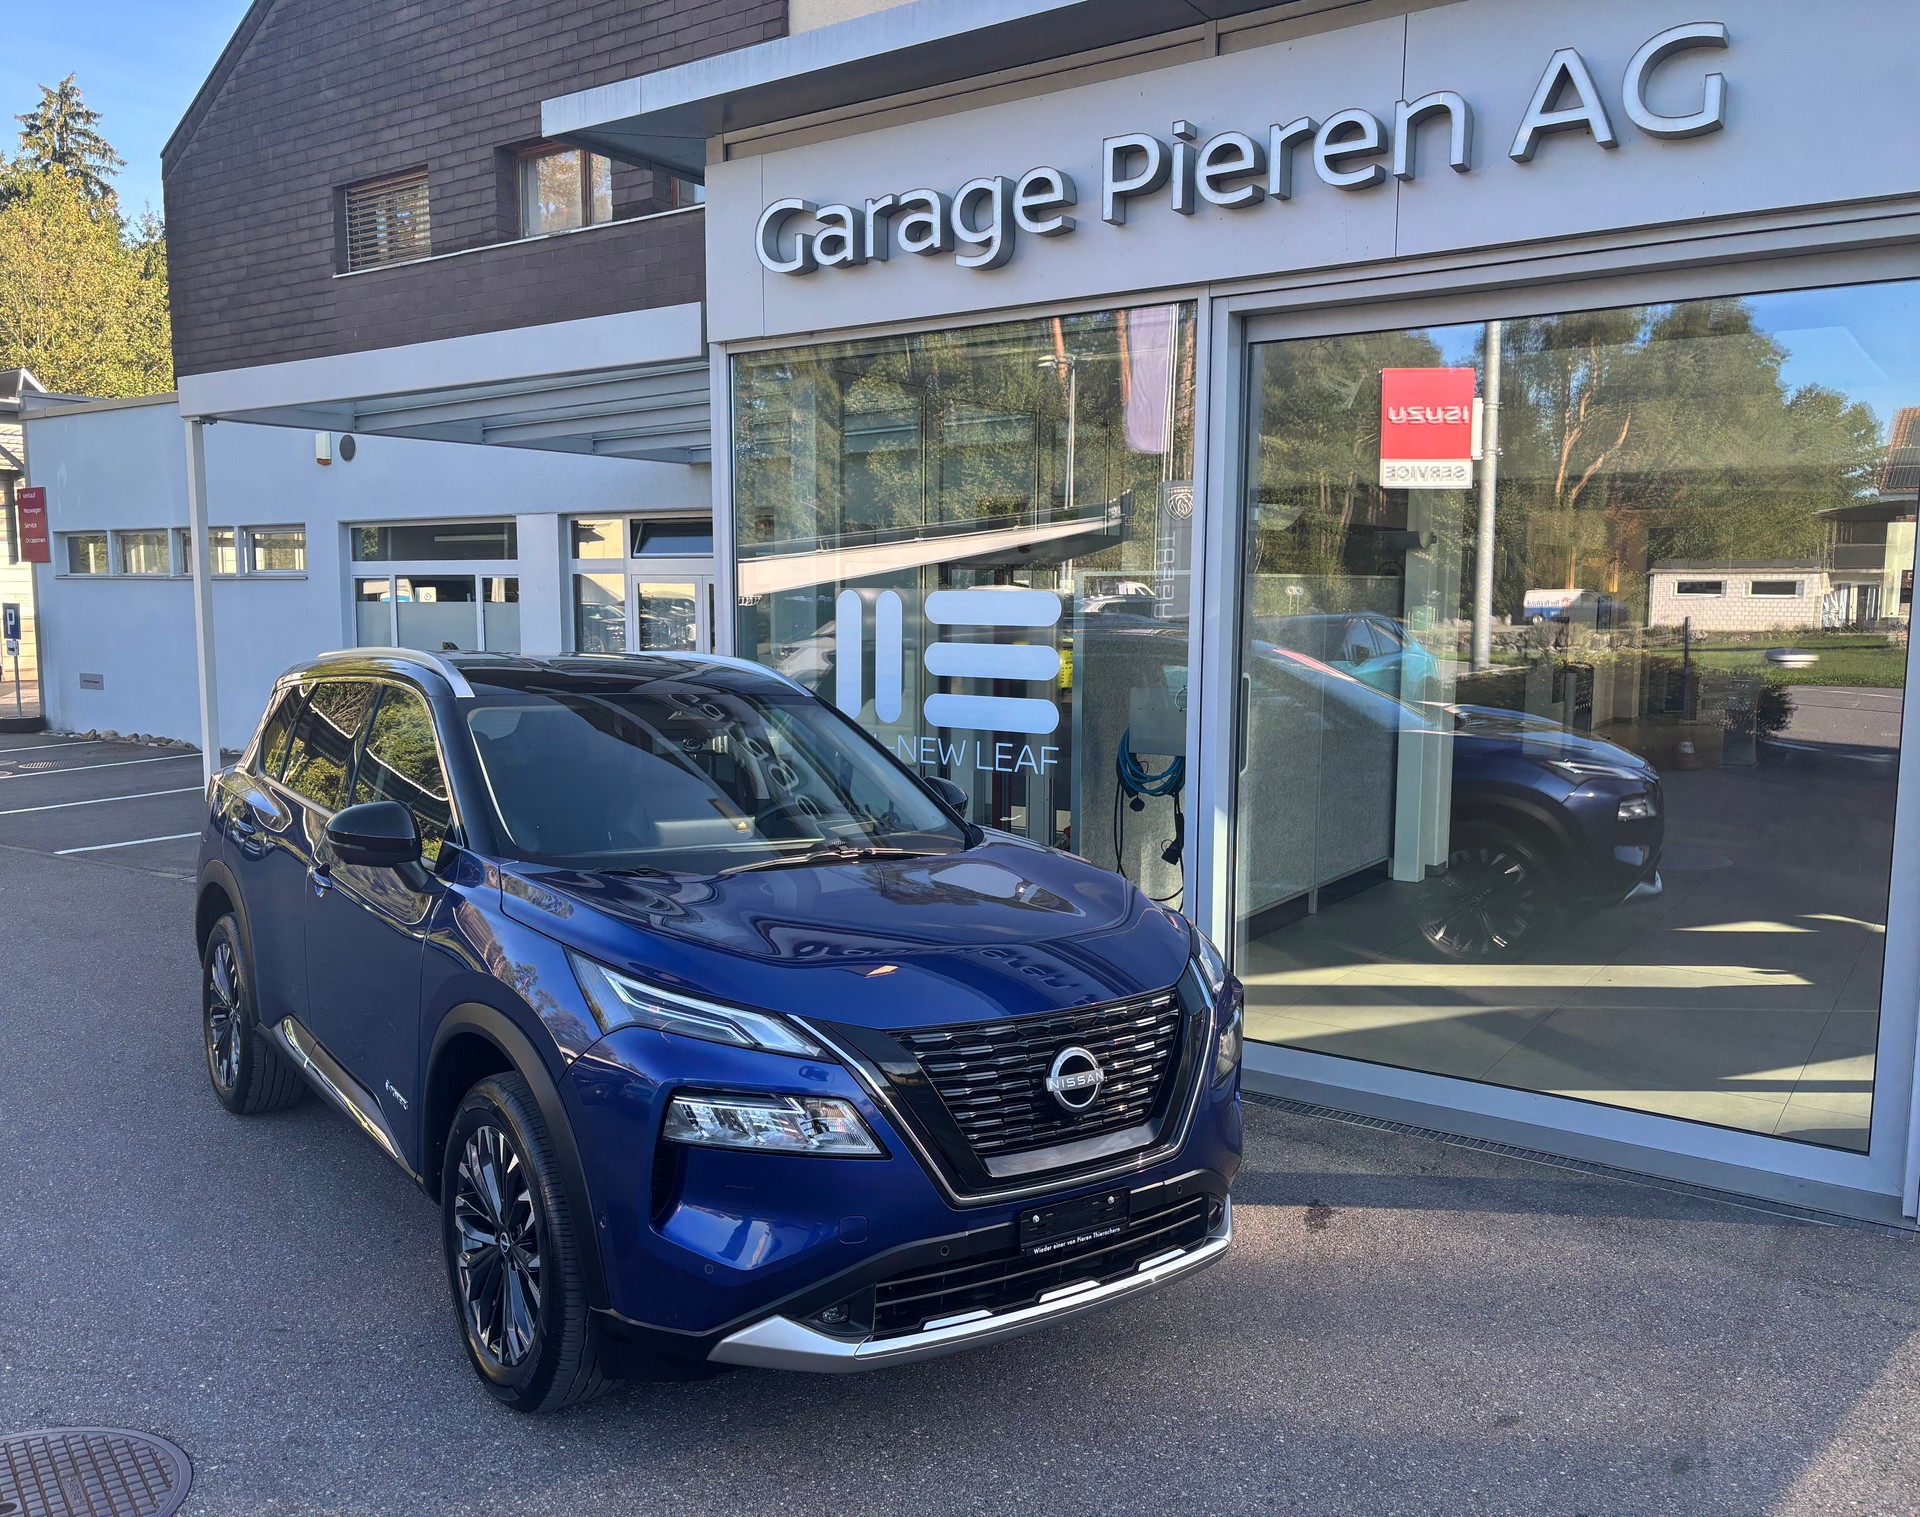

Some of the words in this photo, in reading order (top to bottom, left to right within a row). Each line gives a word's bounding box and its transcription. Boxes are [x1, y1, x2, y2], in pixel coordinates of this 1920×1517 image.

[754, 165, 1077, 277] Garage
[1102, 90, 1473, 225] Pieren
[1508, 21, 1730, 163] AG
[6, 608, 15, 635] P
[976, 740, 1060, 775] LEAF
[1049, 1071, 1104, 1090] NISSAN
[1034, 1245, 1052, 1255] Wieder
[1053, 1241, 1066, 1250] einer
[1077, 1234, 1092, 1243] Pieren
